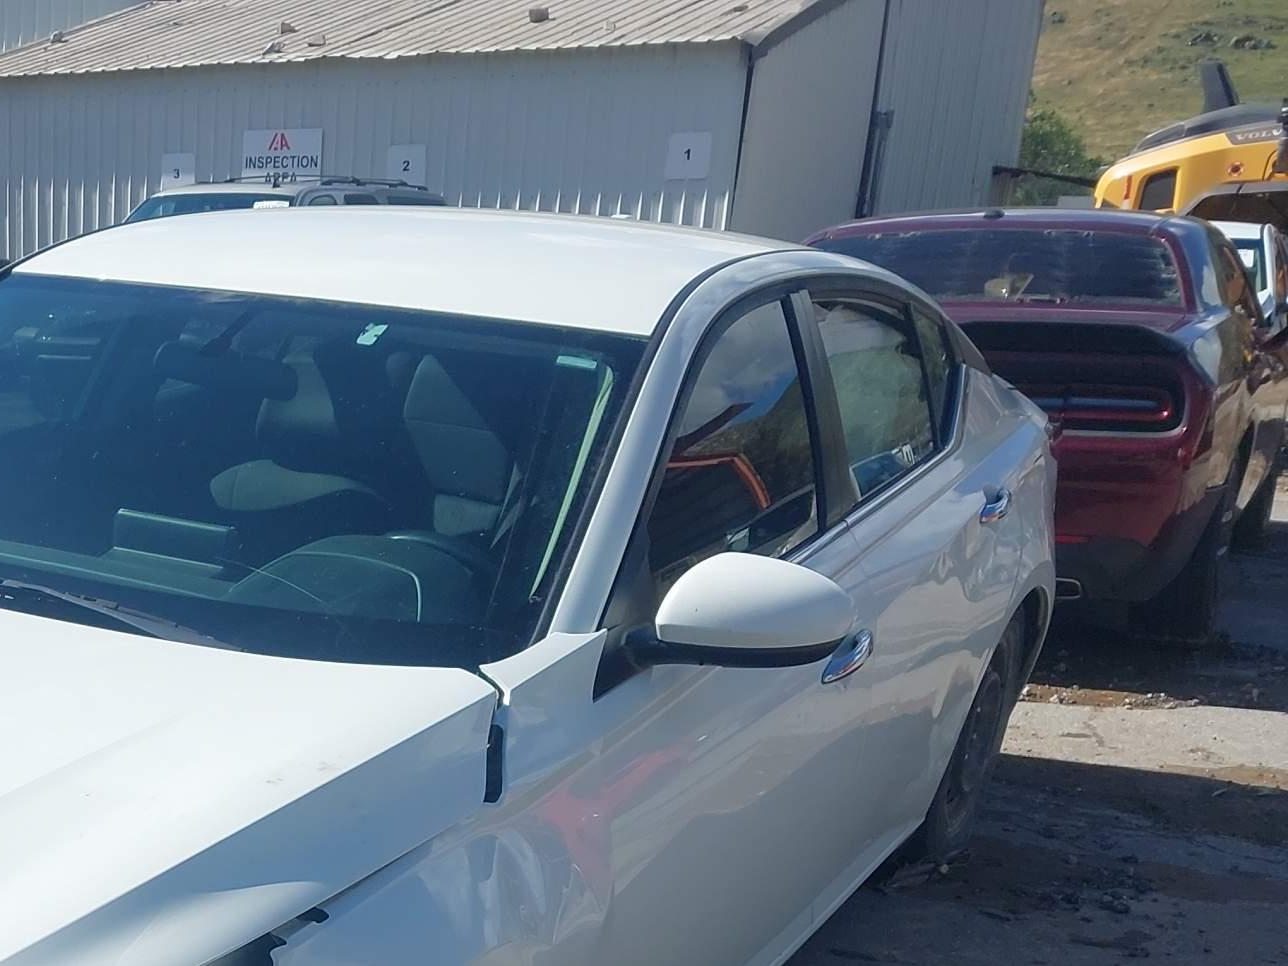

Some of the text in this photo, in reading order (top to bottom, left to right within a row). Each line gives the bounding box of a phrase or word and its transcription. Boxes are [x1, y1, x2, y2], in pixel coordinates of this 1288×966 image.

[1236, 127, 1284, 141] VOLV
[684, 148, 691, 161] 1
[245, 155, 319, 169] INSPECTION
[402, 160, 410, 171] 2
[173, 168, 180, 179] 3
